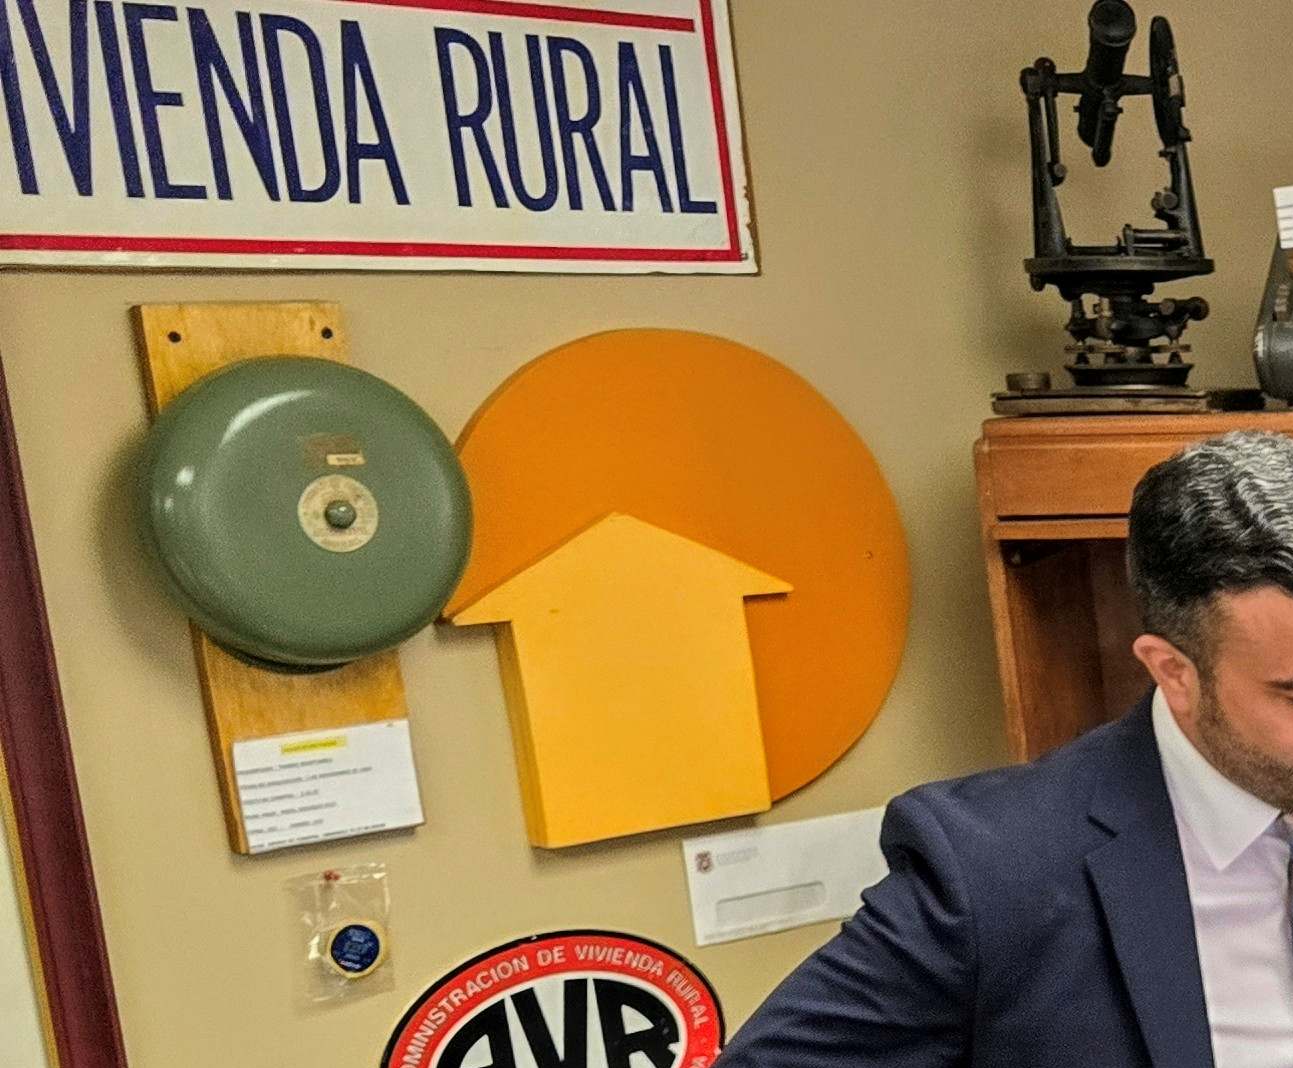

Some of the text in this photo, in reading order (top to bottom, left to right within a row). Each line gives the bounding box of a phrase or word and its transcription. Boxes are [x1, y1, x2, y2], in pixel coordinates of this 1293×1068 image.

[0, 0, 717, 214] IVIENDA RURAL
[536, 945, 567, 966] DE
[574, 944, 664, 978] VIVIENDA
[666, 968, 709, 1030] RURAL
